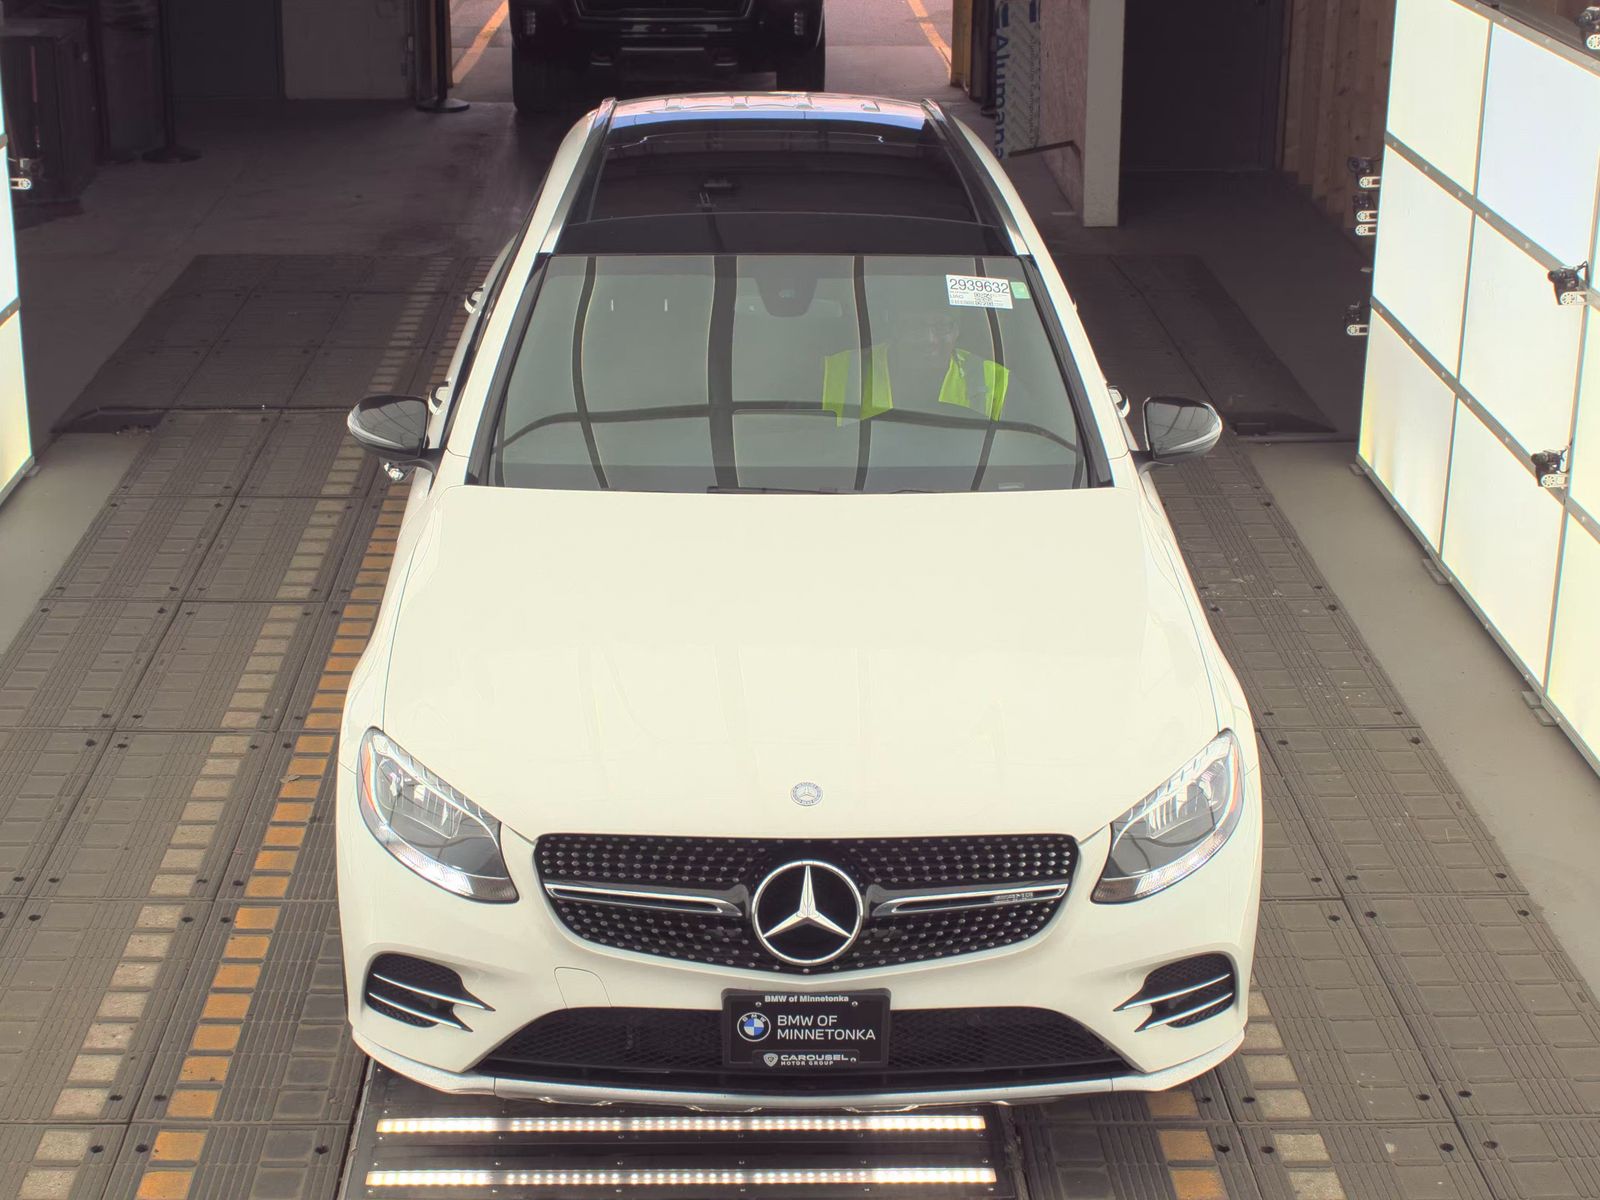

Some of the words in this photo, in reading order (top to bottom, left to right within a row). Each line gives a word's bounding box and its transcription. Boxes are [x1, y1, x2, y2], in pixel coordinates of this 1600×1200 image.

[949, 278, 1009, 294] 2939632
[764, 995, 787, 1003] BMW
[788, 995, 798, 1003] of
[799, 995, 849, 1003] Minnetonka
[777, 1015, 814, 1027] BMW
[817, 1015, 838, 1027] OF
[777, 1029, 876, 1041] MINNETONKA
